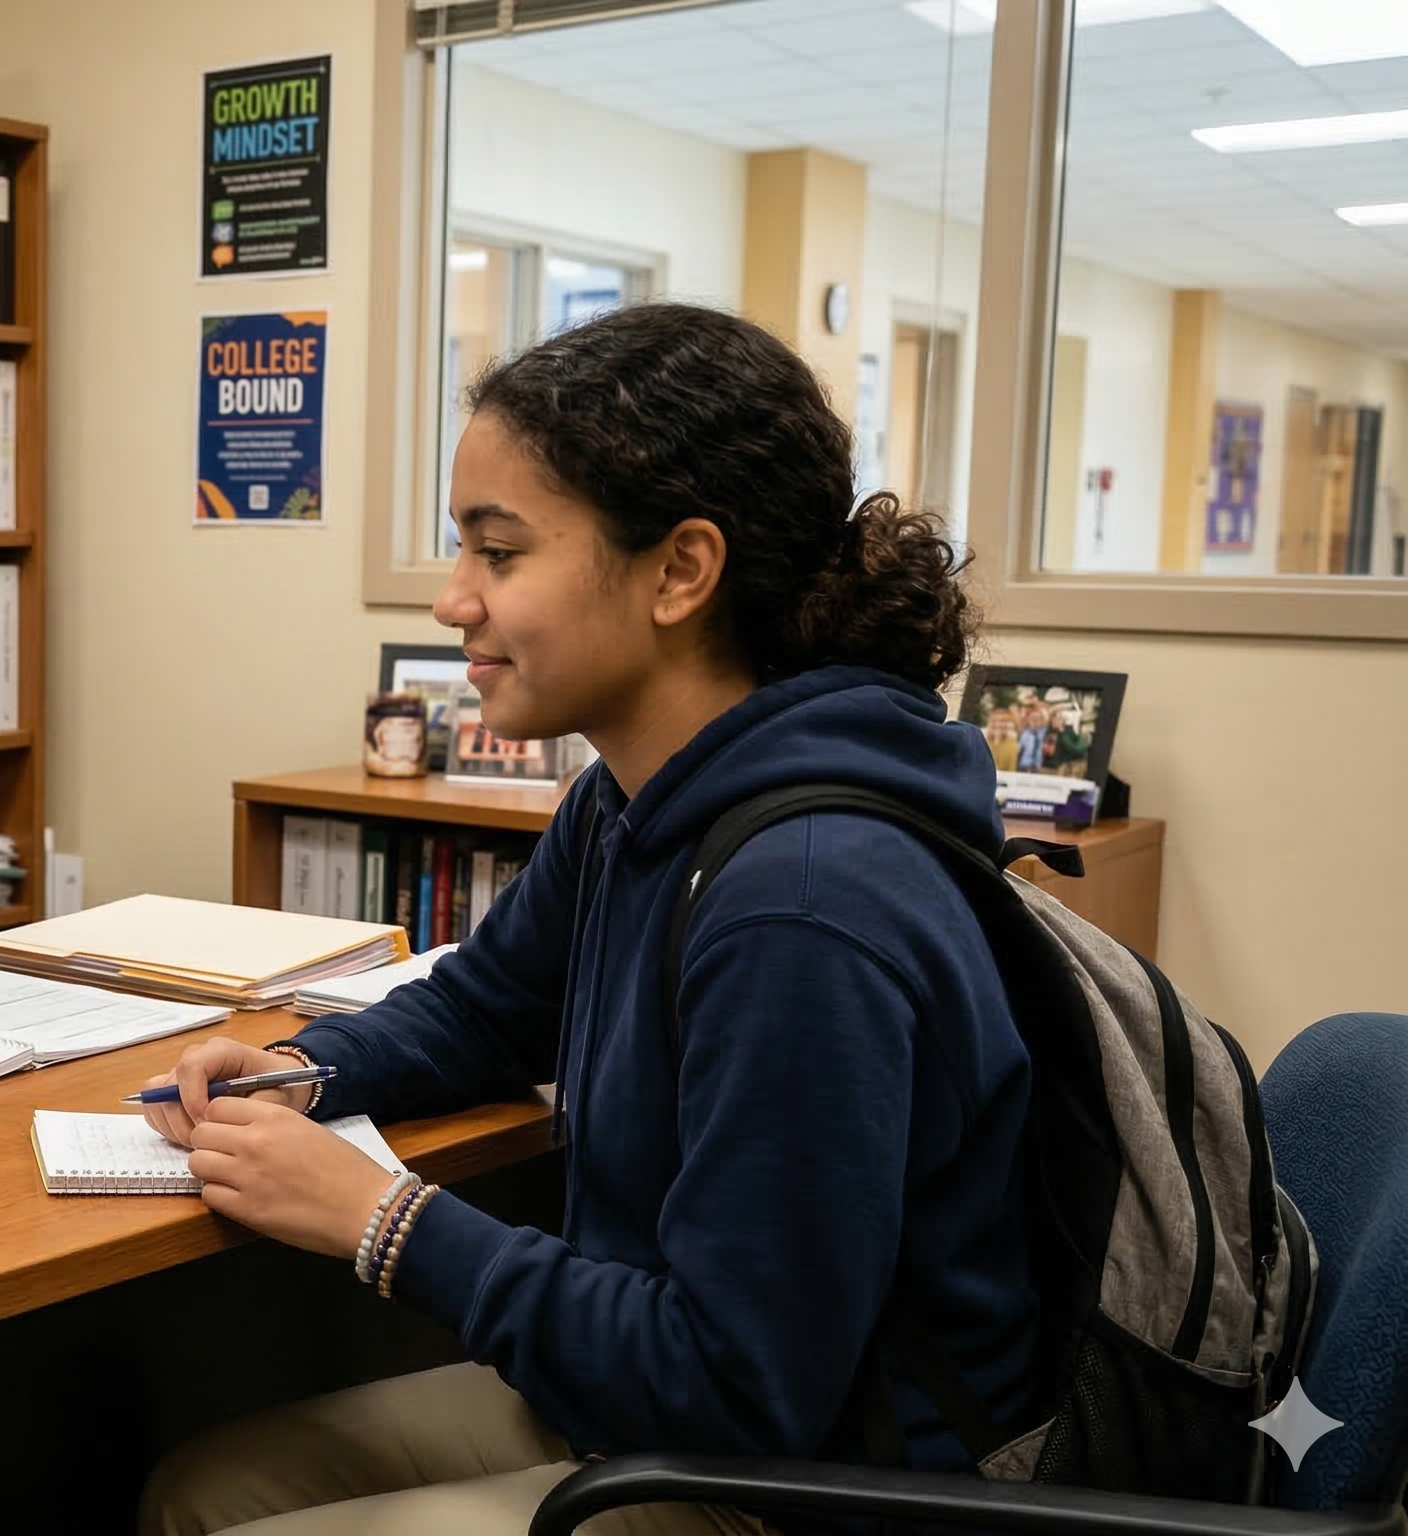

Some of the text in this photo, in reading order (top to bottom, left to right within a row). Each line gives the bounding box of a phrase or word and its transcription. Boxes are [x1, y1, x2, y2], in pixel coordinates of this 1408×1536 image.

[213, 77, 318, 125] GROWTH
[213, 116, 319, 163] MINDSET
[207, 337, 318, 377] COLLEGE
[218, 377, 303, 415] BOUND
